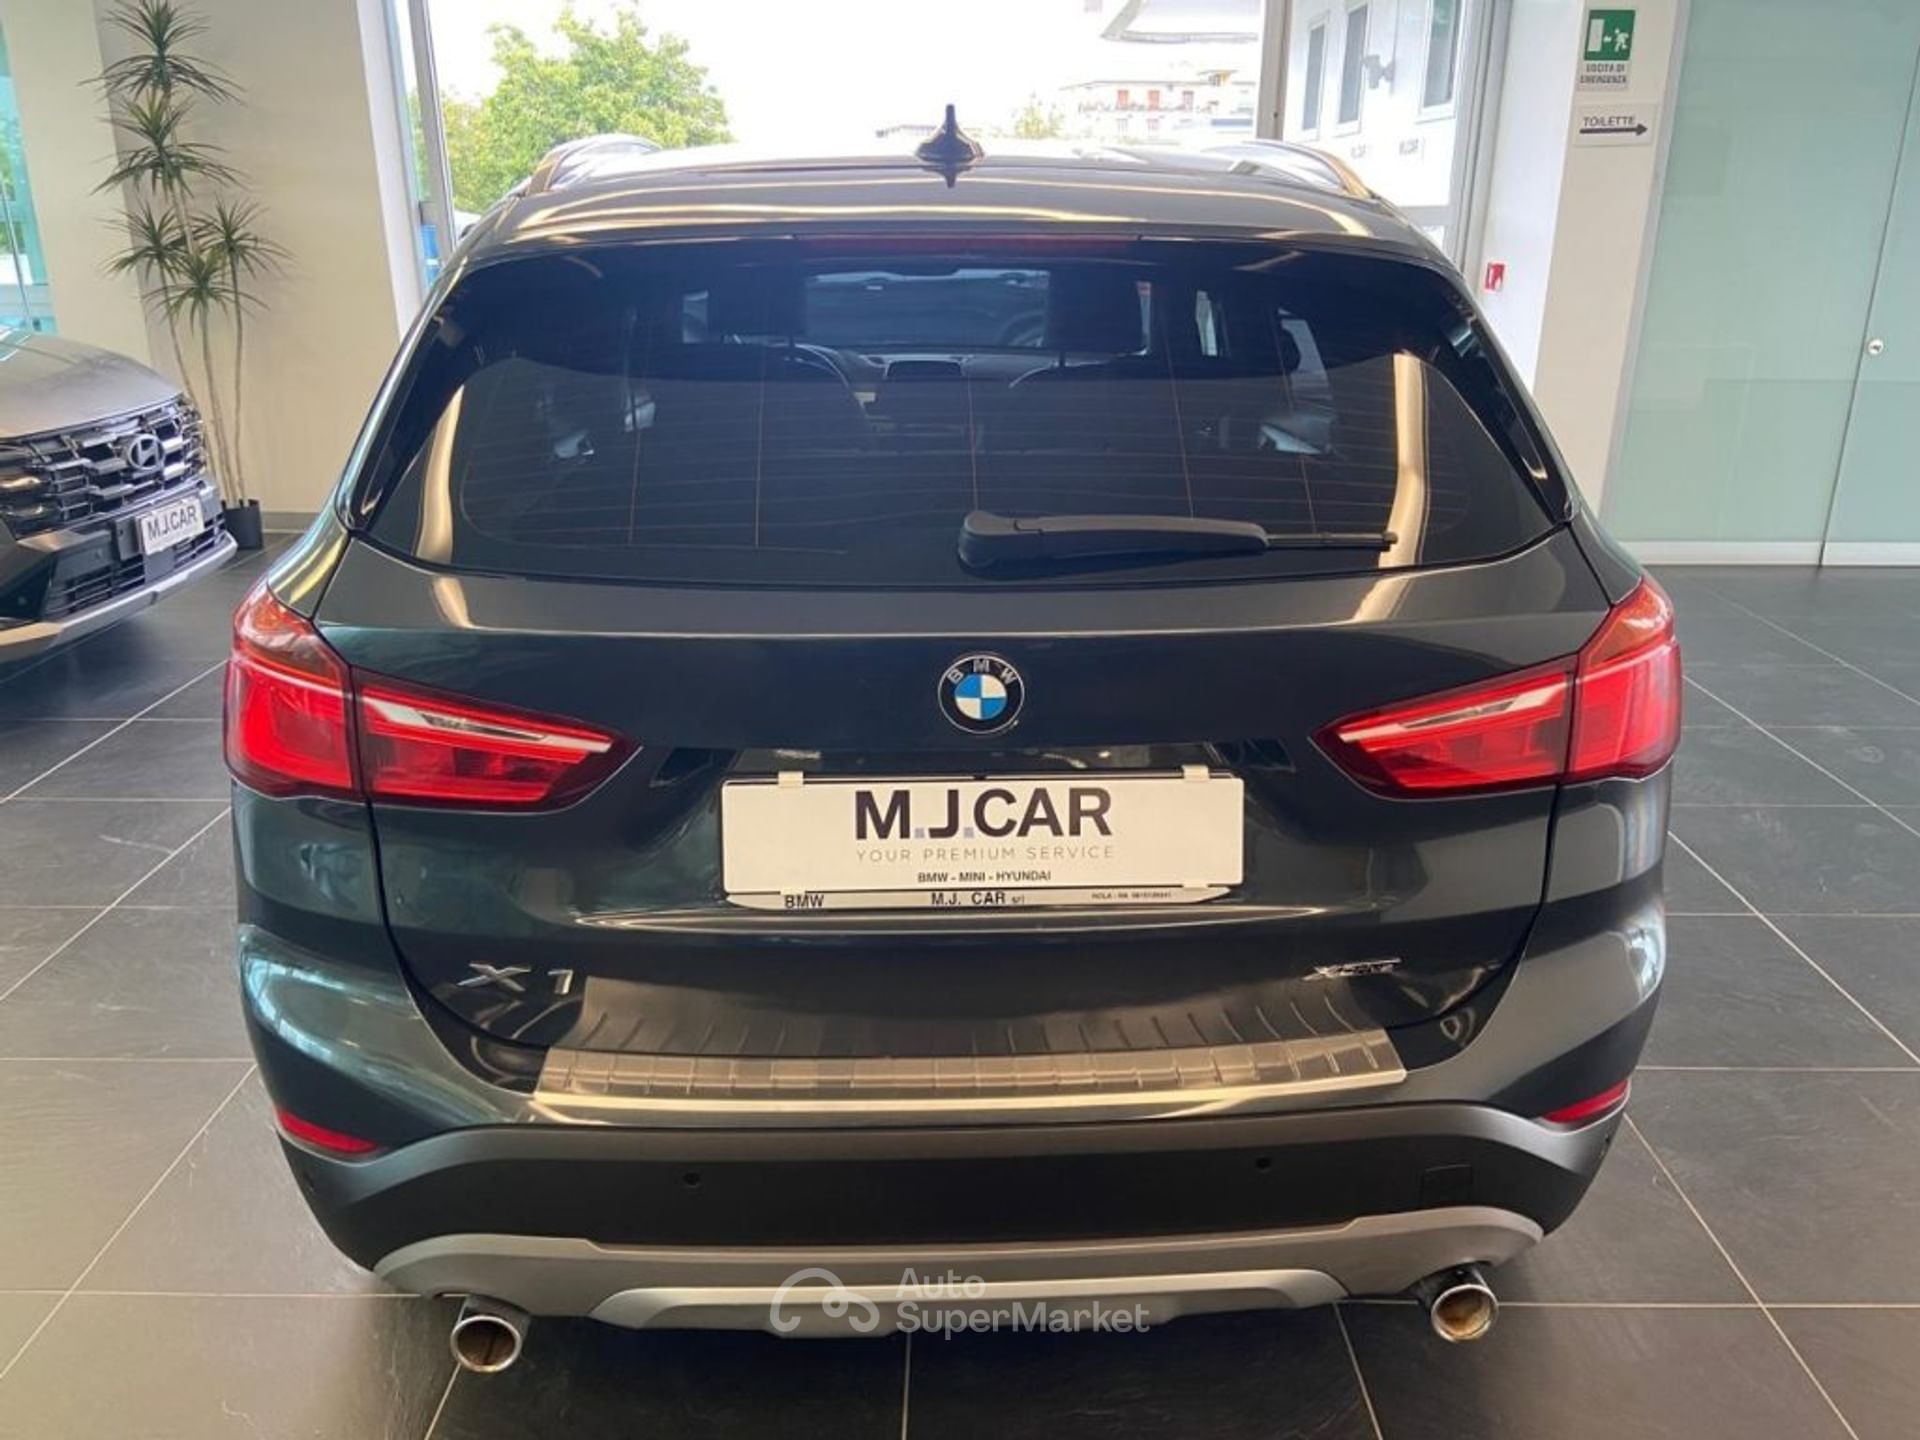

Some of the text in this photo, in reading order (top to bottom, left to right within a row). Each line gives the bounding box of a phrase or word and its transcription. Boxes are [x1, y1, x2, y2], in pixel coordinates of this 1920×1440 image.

[1583, 116, 1636, 127] TOILETTE
[946, 659, 1018, 685] BMW
[855, 787, 1113, 840] M.J.CAR
[856, 845, 1113, 863] YOUR PREMIUM SERVICE
[917, 872, 948, 883] BMW
[959, 871, 986, 882] MINI
[996, 870, 1052, 882] HYUNDAI
[784, 894, 824, 909] BMW
[931, 892, 962, 905] M.J.
[971, 891, 1006, 905] CAR
